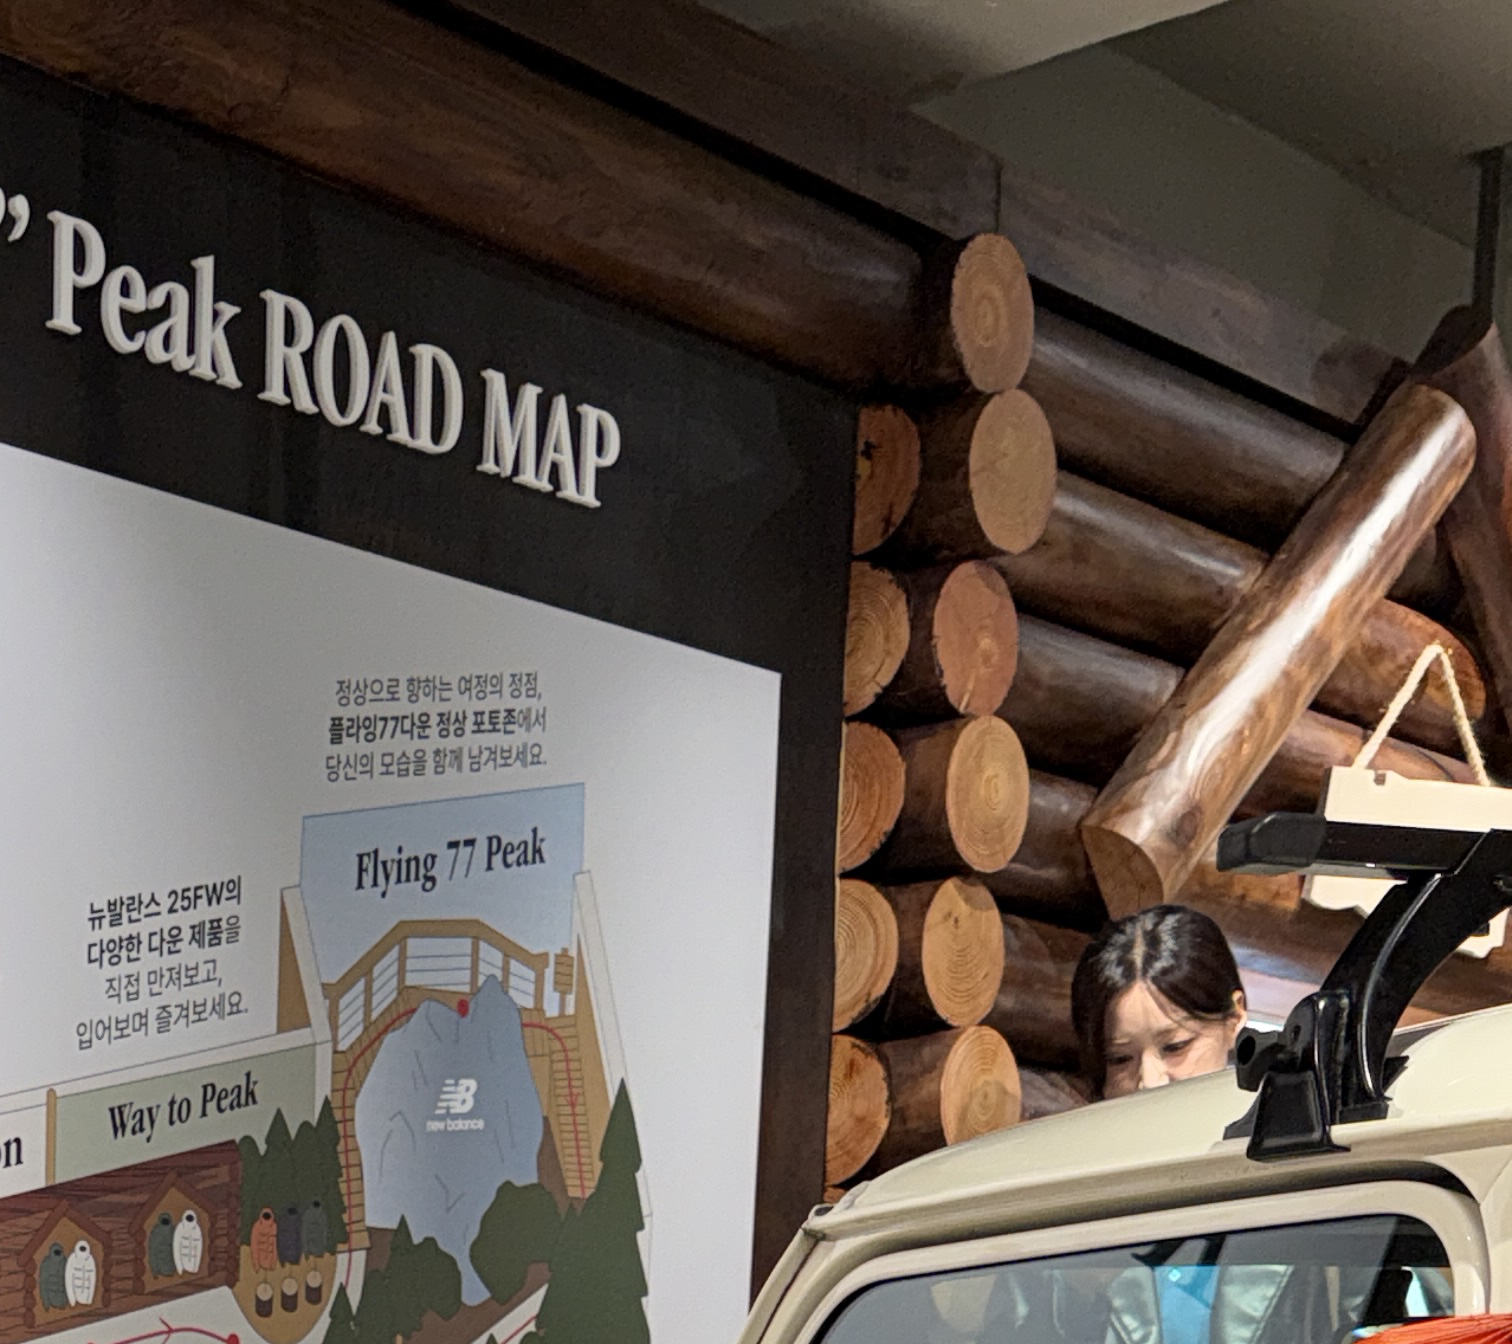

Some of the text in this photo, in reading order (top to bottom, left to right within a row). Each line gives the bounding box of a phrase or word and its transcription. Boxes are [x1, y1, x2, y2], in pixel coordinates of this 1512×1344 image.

[46, 209, 243, 388] Peak
[257, 288, 464, 454] ROAD
[476, 368, 621, 507] MAP
[336, 678, 400, 707] 정상으로
[406, 675, 453, 703] 향하는
[458, 672, 503, 700] 여정의
[329, 706, 547, 744] 플라잉77다운 정상 포토존에서
[326, 743, 547, 782] 당신의 모습을 함께 남겨보세요.
[355, 827, 546, 898] Flying 77 Peak
[88, 875, 241, 931] 뉴발란스 25FW의
[87, 915, 241, 969] 다양한 다운 제품을
[105, 959, 223, 1004] 직접 만져보고,
[76, 991, 248, 1050] 입어보며 즐겨보세요.
[108, 1070, 258, 1143] Way to Peak
